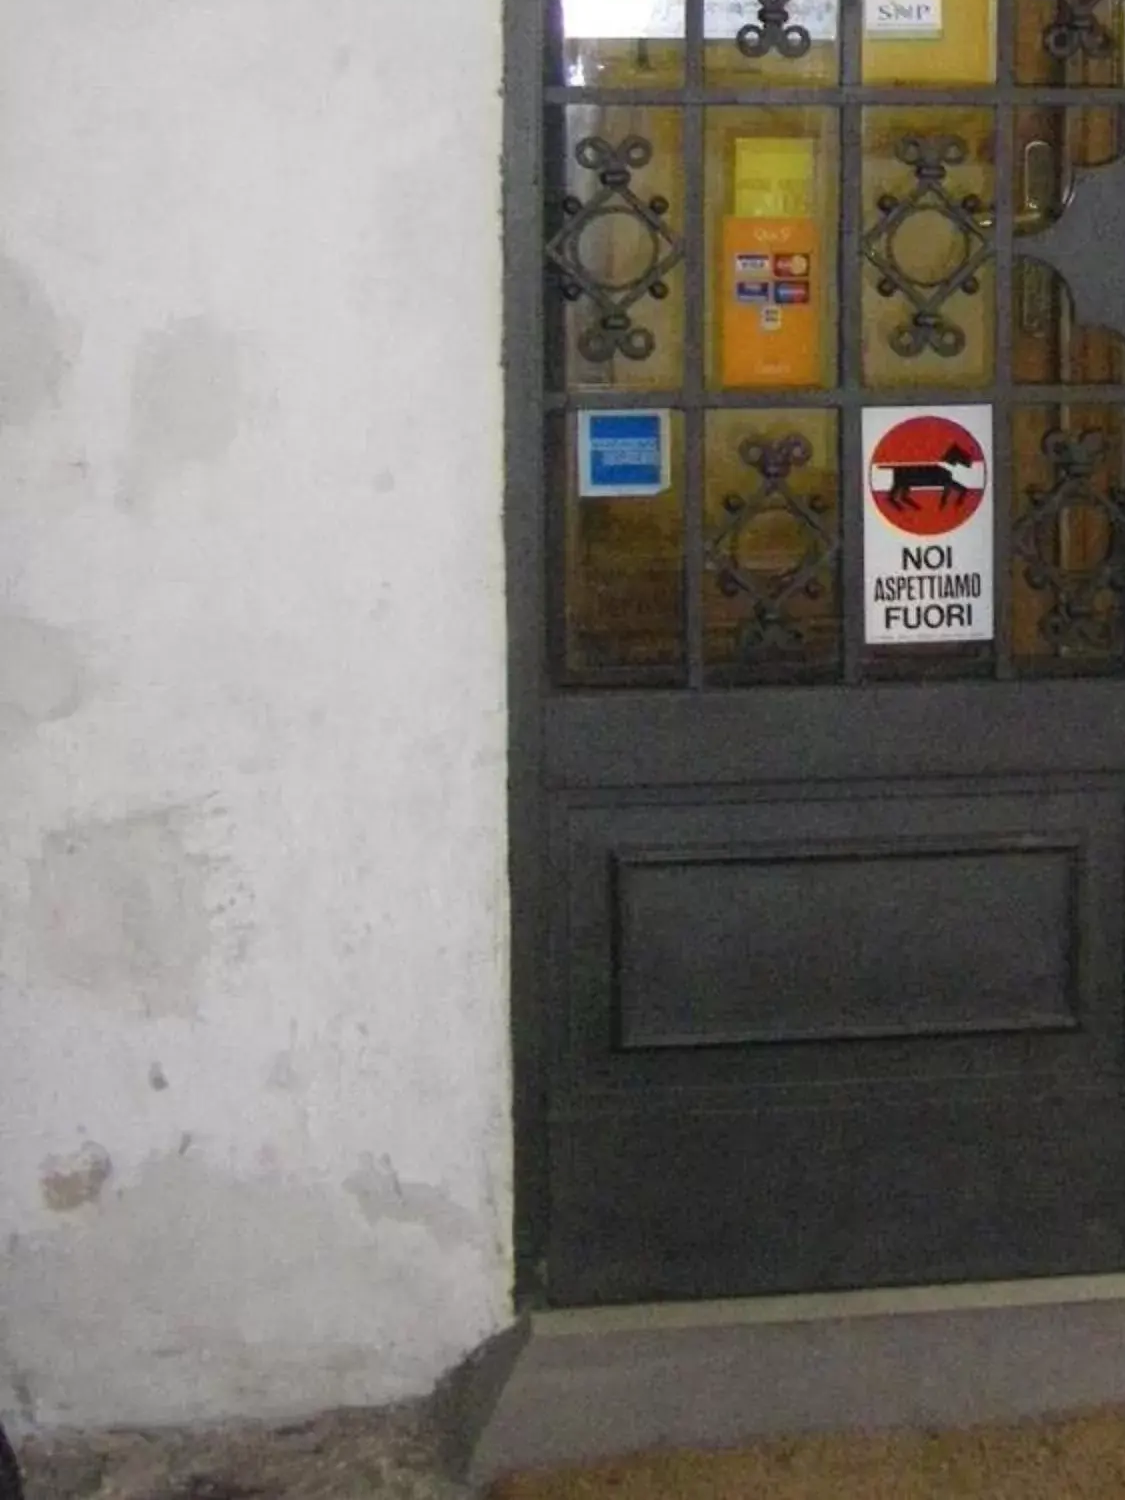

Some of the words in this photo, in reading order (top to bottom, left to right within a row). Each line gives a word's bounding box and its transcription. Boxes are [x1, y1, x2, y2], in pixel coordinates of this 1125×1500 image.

[901, 545, 953, 571] NOI
[874, 572, 982, 602] ASPETTIAMO
[884, 603, 973, 630] FUORI
